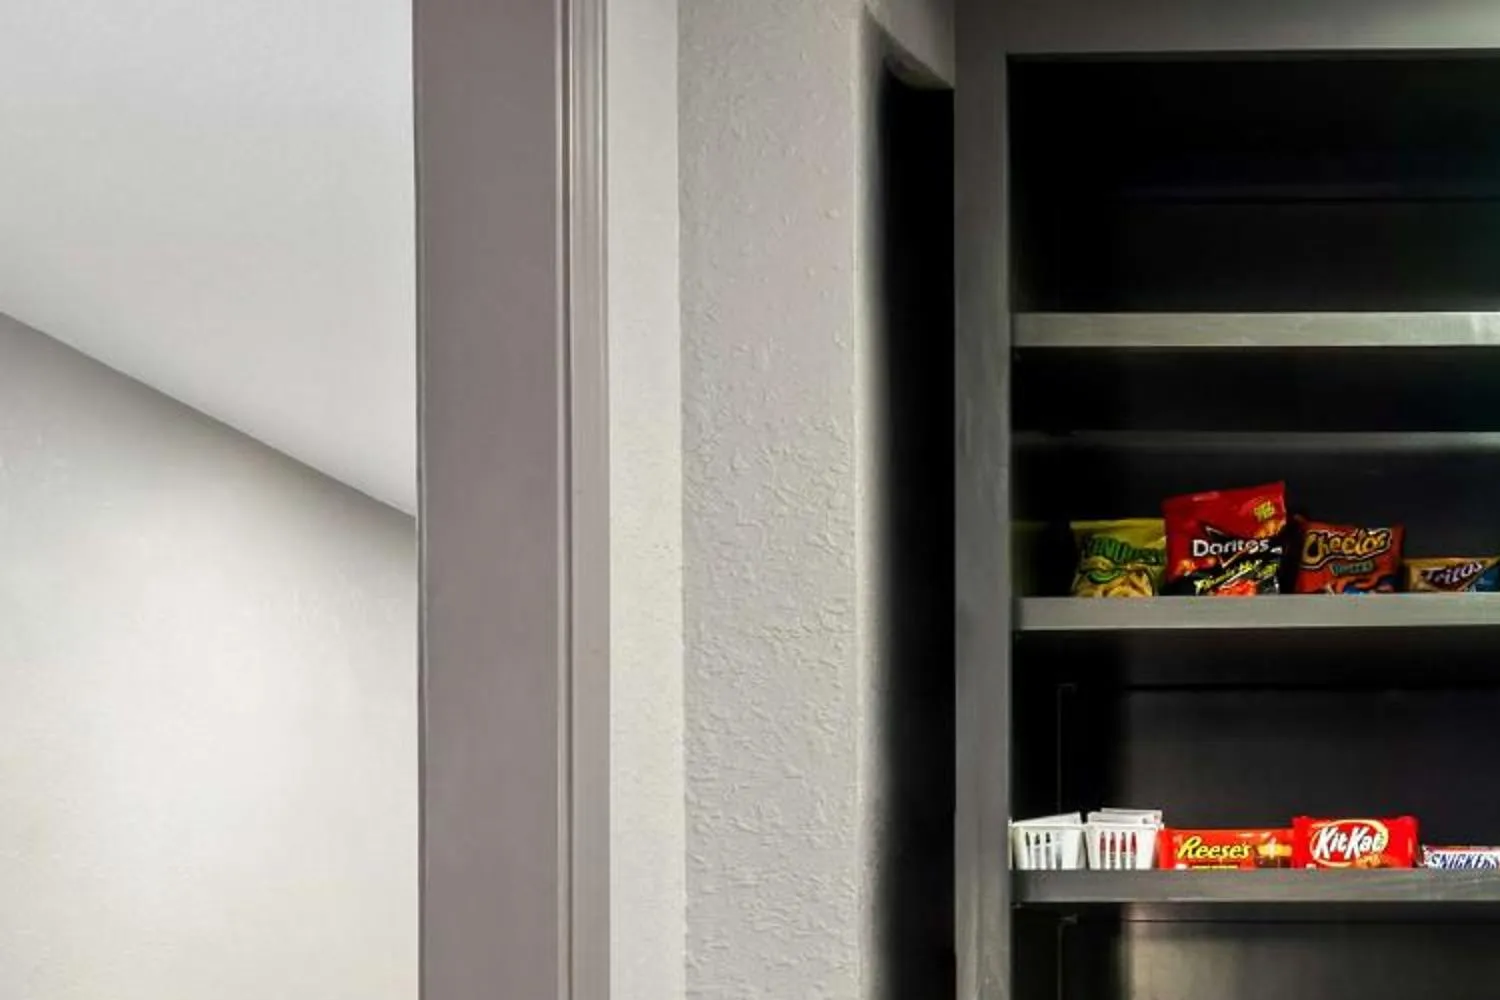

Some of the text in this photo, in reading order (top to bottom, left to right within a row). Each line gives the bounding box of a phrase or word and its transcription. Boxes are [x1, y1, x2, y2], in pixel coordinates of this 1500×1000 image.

[1193, 539, 1270, 556] Doritos
[1303, 527, 1388, 565] Cheetos
[1178, 836, 1252, 859] Reese's
